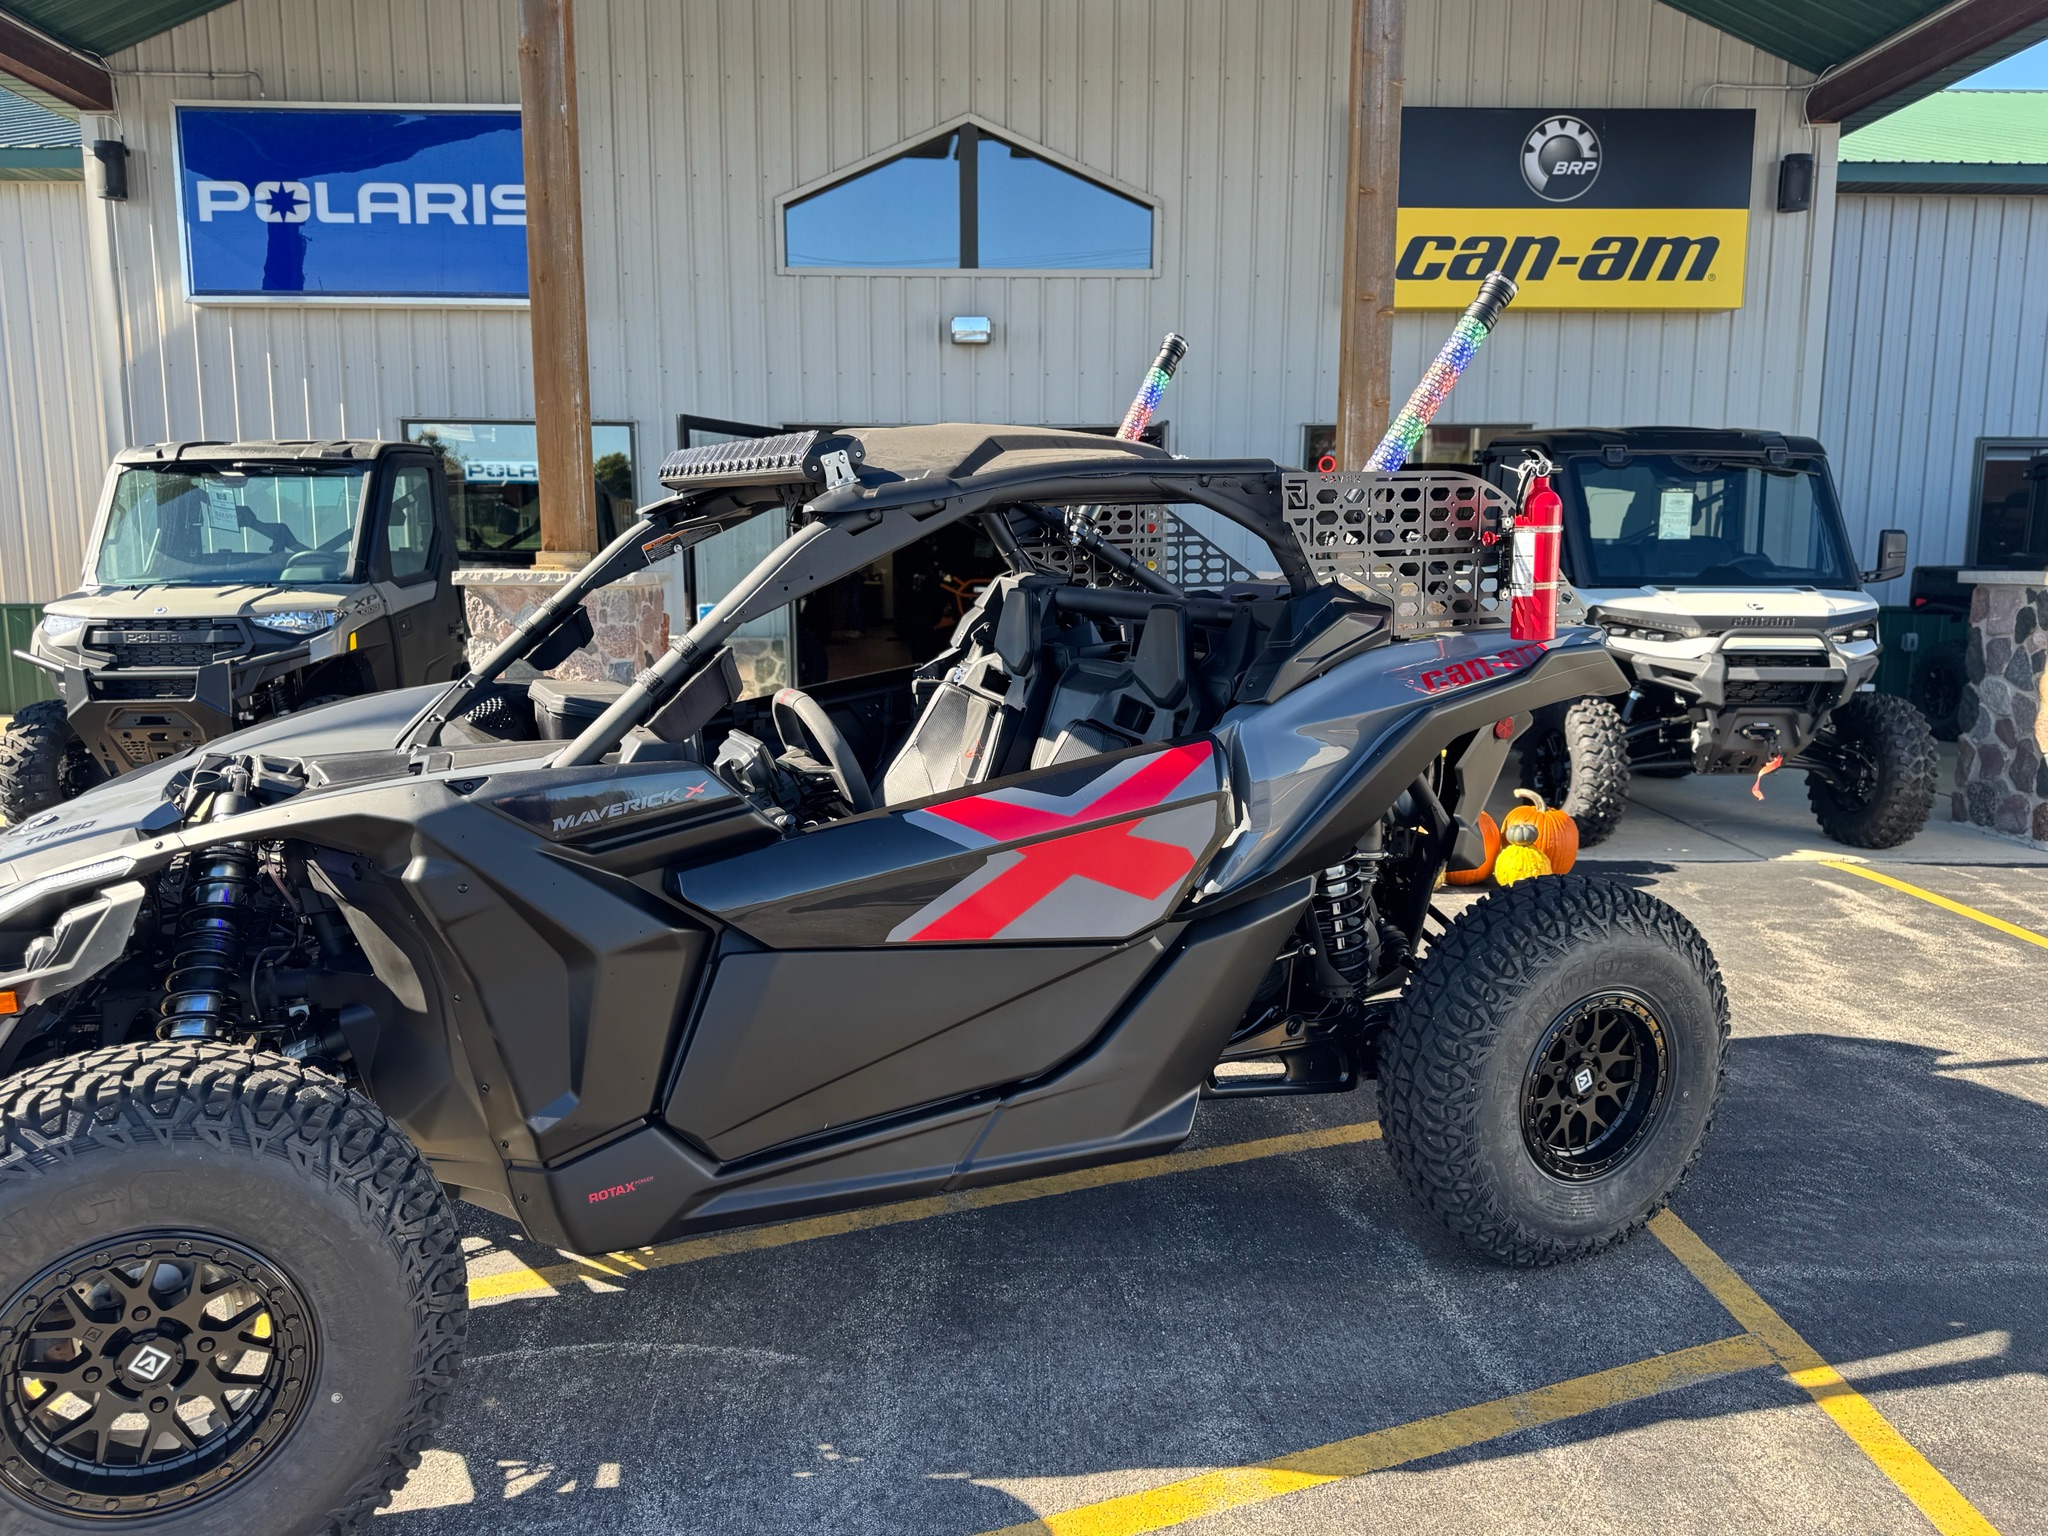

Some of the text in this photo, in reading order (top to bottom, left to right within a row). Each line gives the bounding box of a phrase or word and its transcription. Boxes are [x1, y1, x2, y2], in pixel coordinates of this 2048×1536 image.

[1552, 161, 1597, 175] BRP
[197, 180, 527, 225] POLARIS
[1395, 236, 1720, 281] can-am
[468, 463, 537, 478] POLA
[353, 594, 377, 610] XP
[552, 788, 682, 832] MAVERICK
[25, 820, 98, 846] TURBO
[588, 1176, 654, 1204] ROTAX POWER
